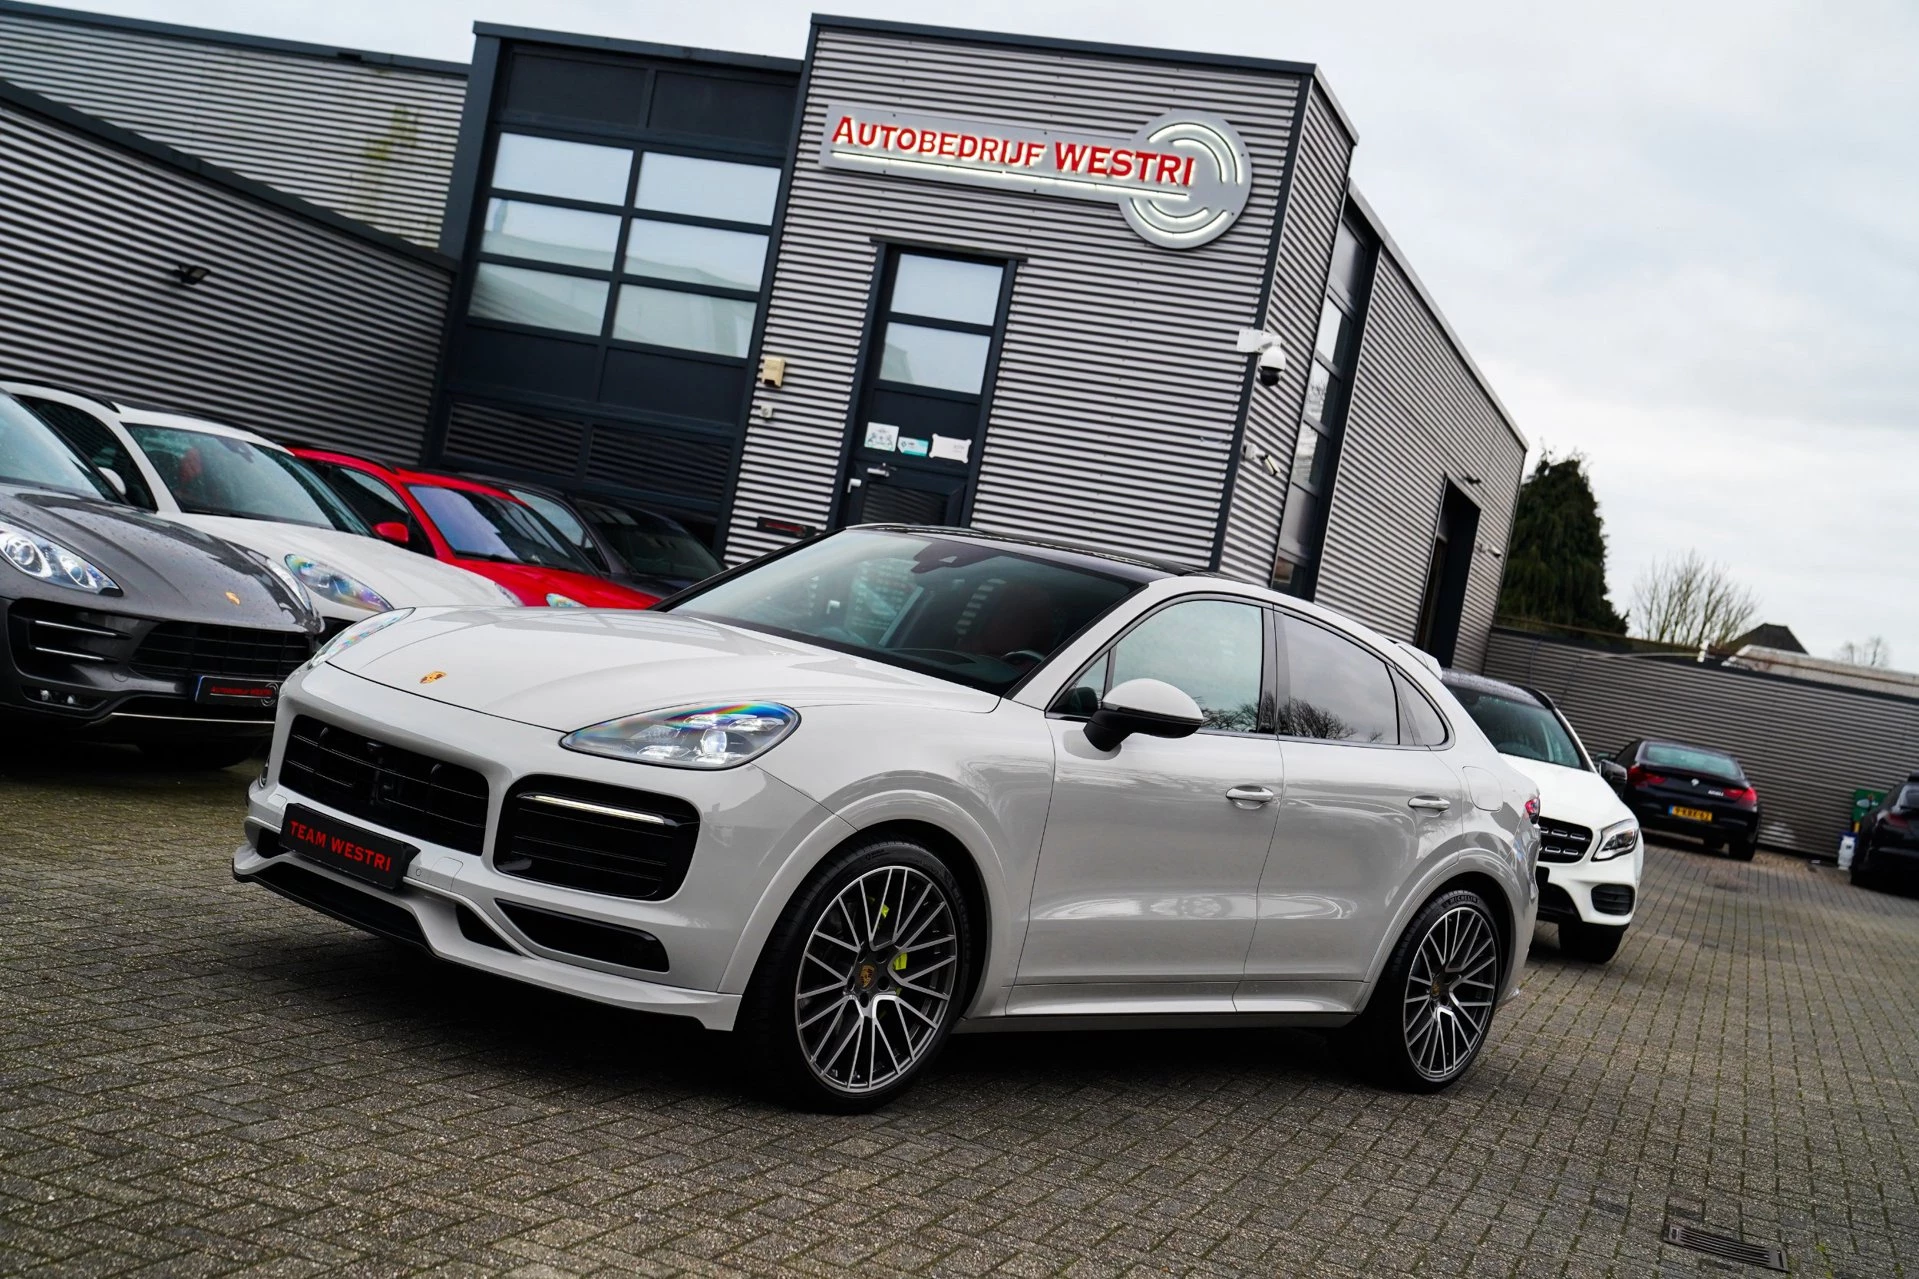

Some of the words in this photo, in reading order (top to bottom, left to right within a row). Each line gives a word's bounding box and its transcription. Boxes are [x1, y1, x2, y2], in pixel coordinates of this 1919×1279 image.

[1056, 143, 1194, 186] WESTRI
[290, 821, 327, 848] TEAM
[332, 838, 392, 872] WESTRI
